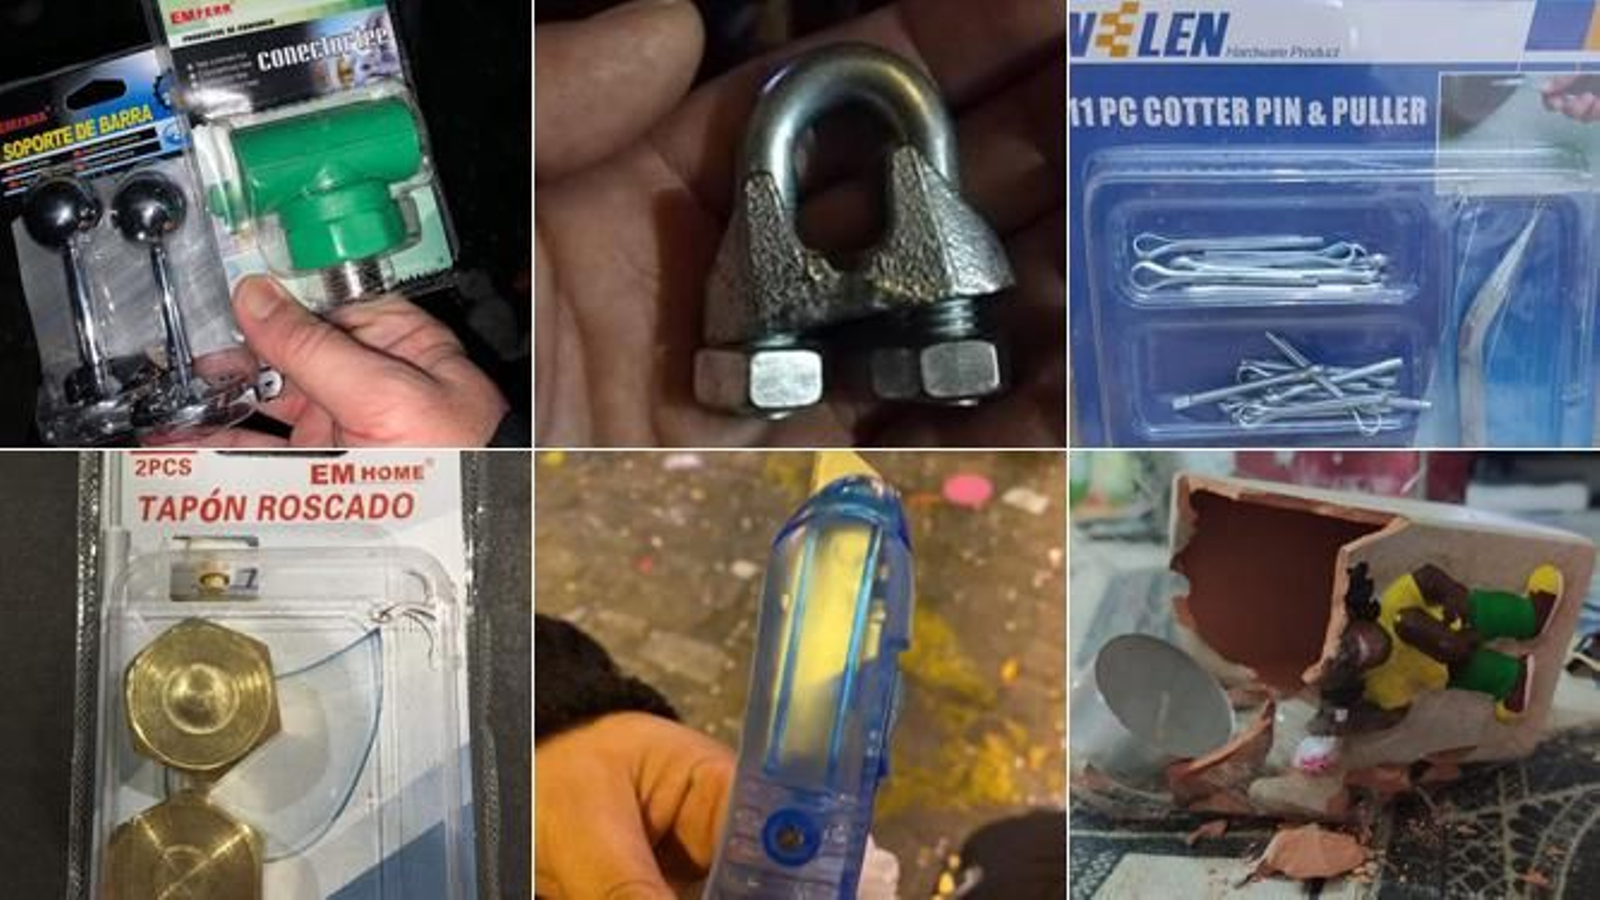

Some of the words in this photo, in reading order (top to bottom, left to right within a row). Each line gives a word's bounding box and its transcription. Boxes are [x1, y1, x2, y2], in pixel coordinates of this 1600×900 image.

[1289, 45, 1341, 57] Product
[1101, 97, 1137, 127] PC
[1143, 96, 1250, 127] COTTER
[1256, 96, 1301, 126] PIN
[1308, 101, 1327, 126] &
[1332, 96, 1428, 126] PULLER
[3, 126, 73, 161] SOPORTE
[75, 119, 96, 140] DE
[100, 104, 153, 133] BARRA
[135, 459, 192, 476] 2PCS
[310, 464, 355, 485] EM
[360, 465, 424, 480] HOME
[139, 488, 246, 522] TAPÓN
[257, 492, 415, 521] ROSCADO
